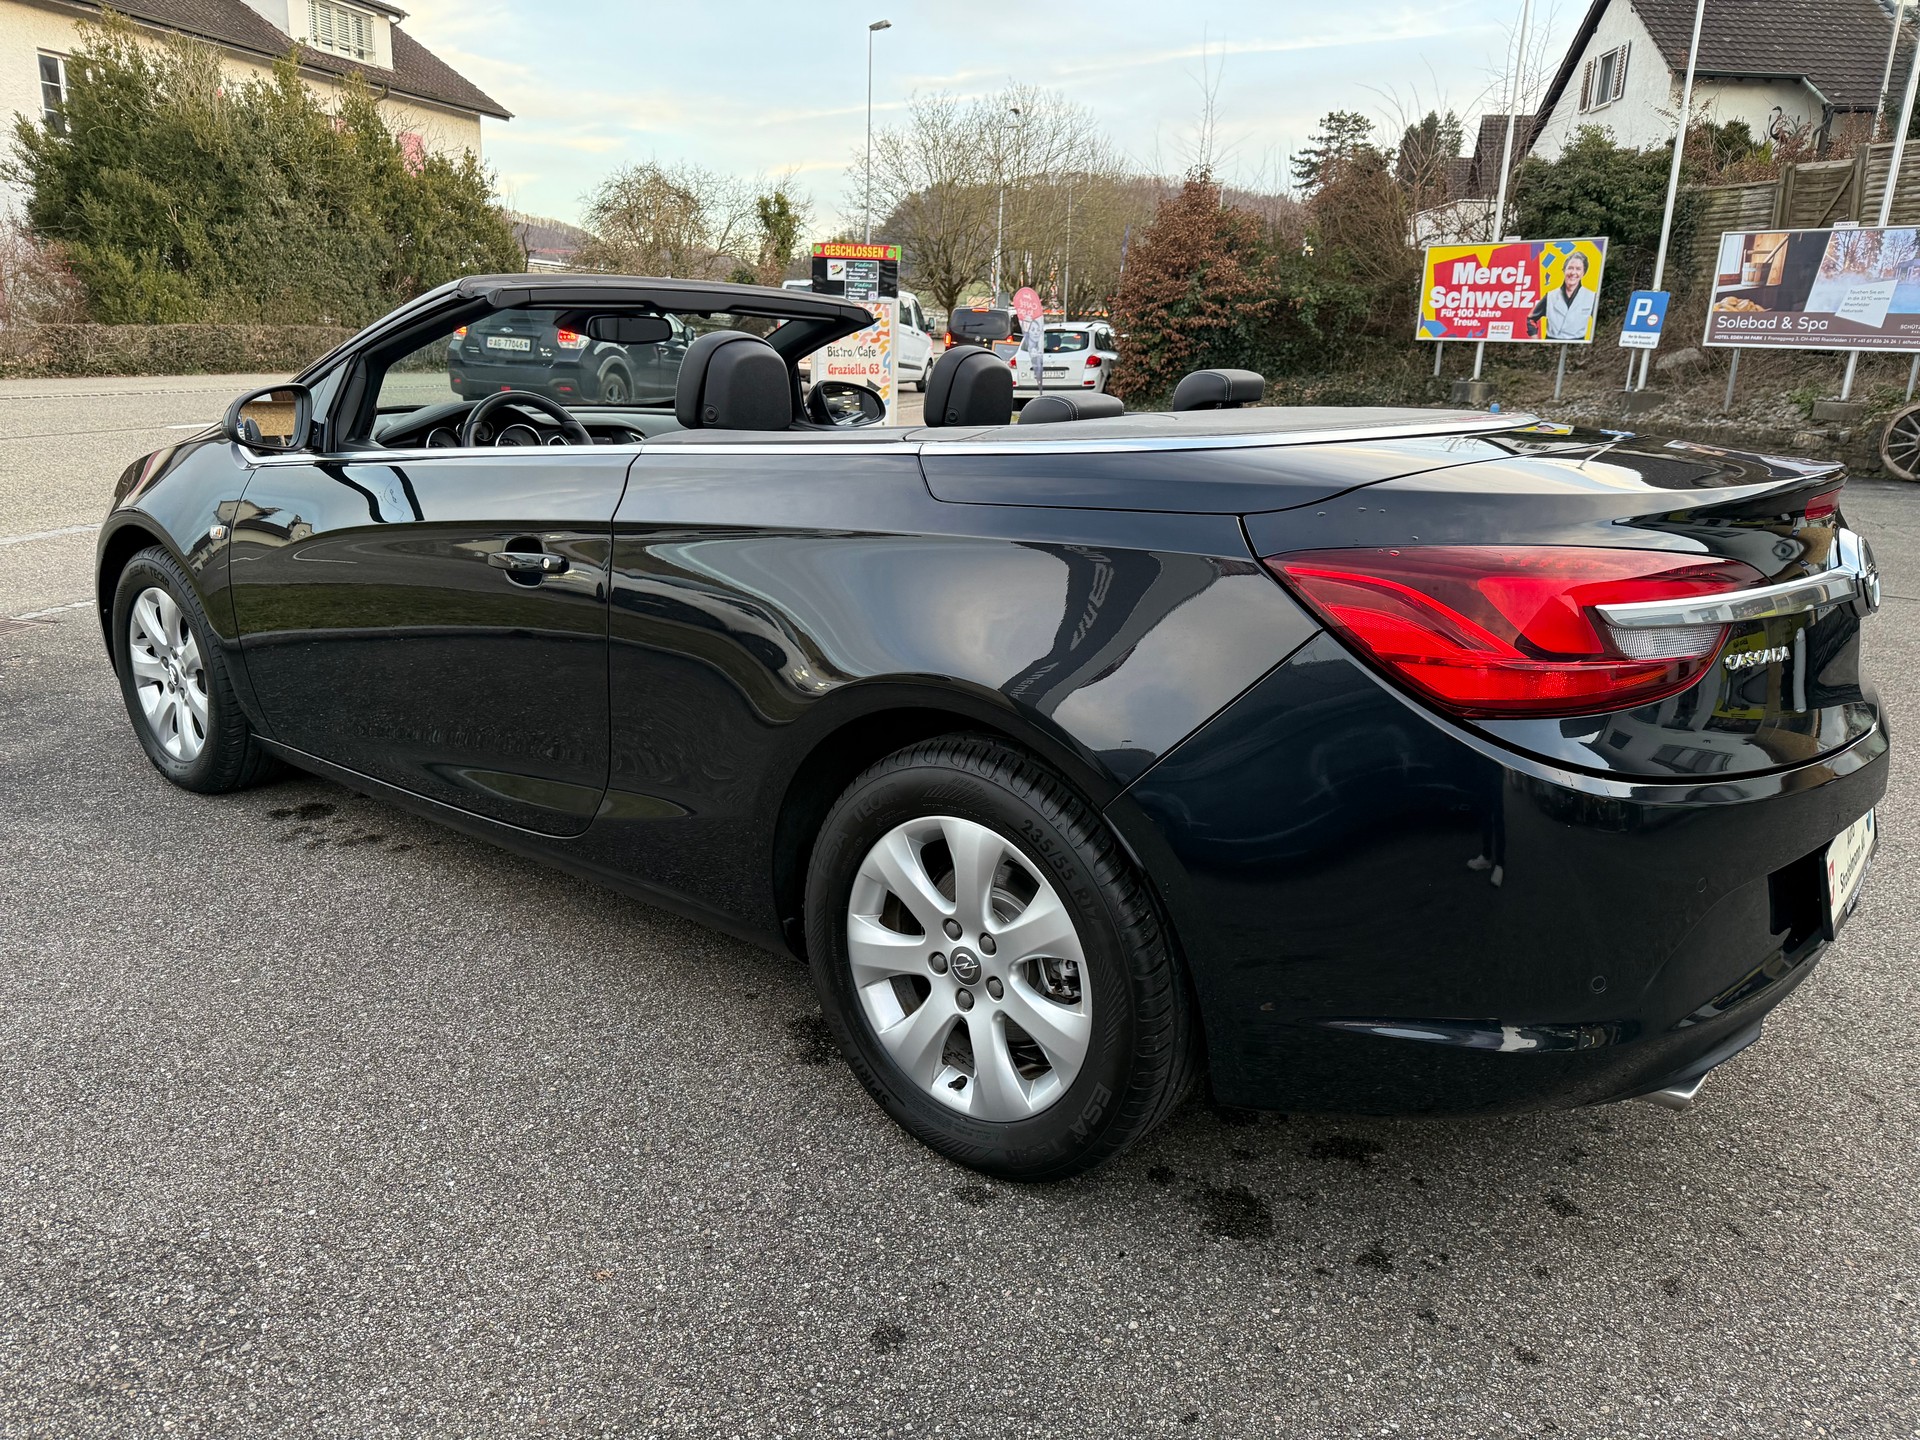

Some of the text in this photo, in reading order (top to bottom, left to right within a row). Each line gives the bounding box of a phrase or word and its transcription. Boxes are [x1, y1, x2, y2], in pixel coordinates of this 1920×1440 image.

[824, 244, 884, 258] GESCHLOSSEN
[1451, 260, 1532, 289] Merci,
[1428, 284, 1541, 309] Schweiz.
[1440, 309, 1502, 318] Für 100 Jahre
[1630, 298, 1653, 326] P
[1452, 318, 1481, 327] Treue.
[1716, 315, 1829, 332] Solebad & Spa
[827, 345, 877, 358] Bistro/Cafe
[827, 363, 880, 376] Graziella 63
[1723, 646, 1791, 670] CASCADA
[1020, 818, 1078, 882] 235/55
